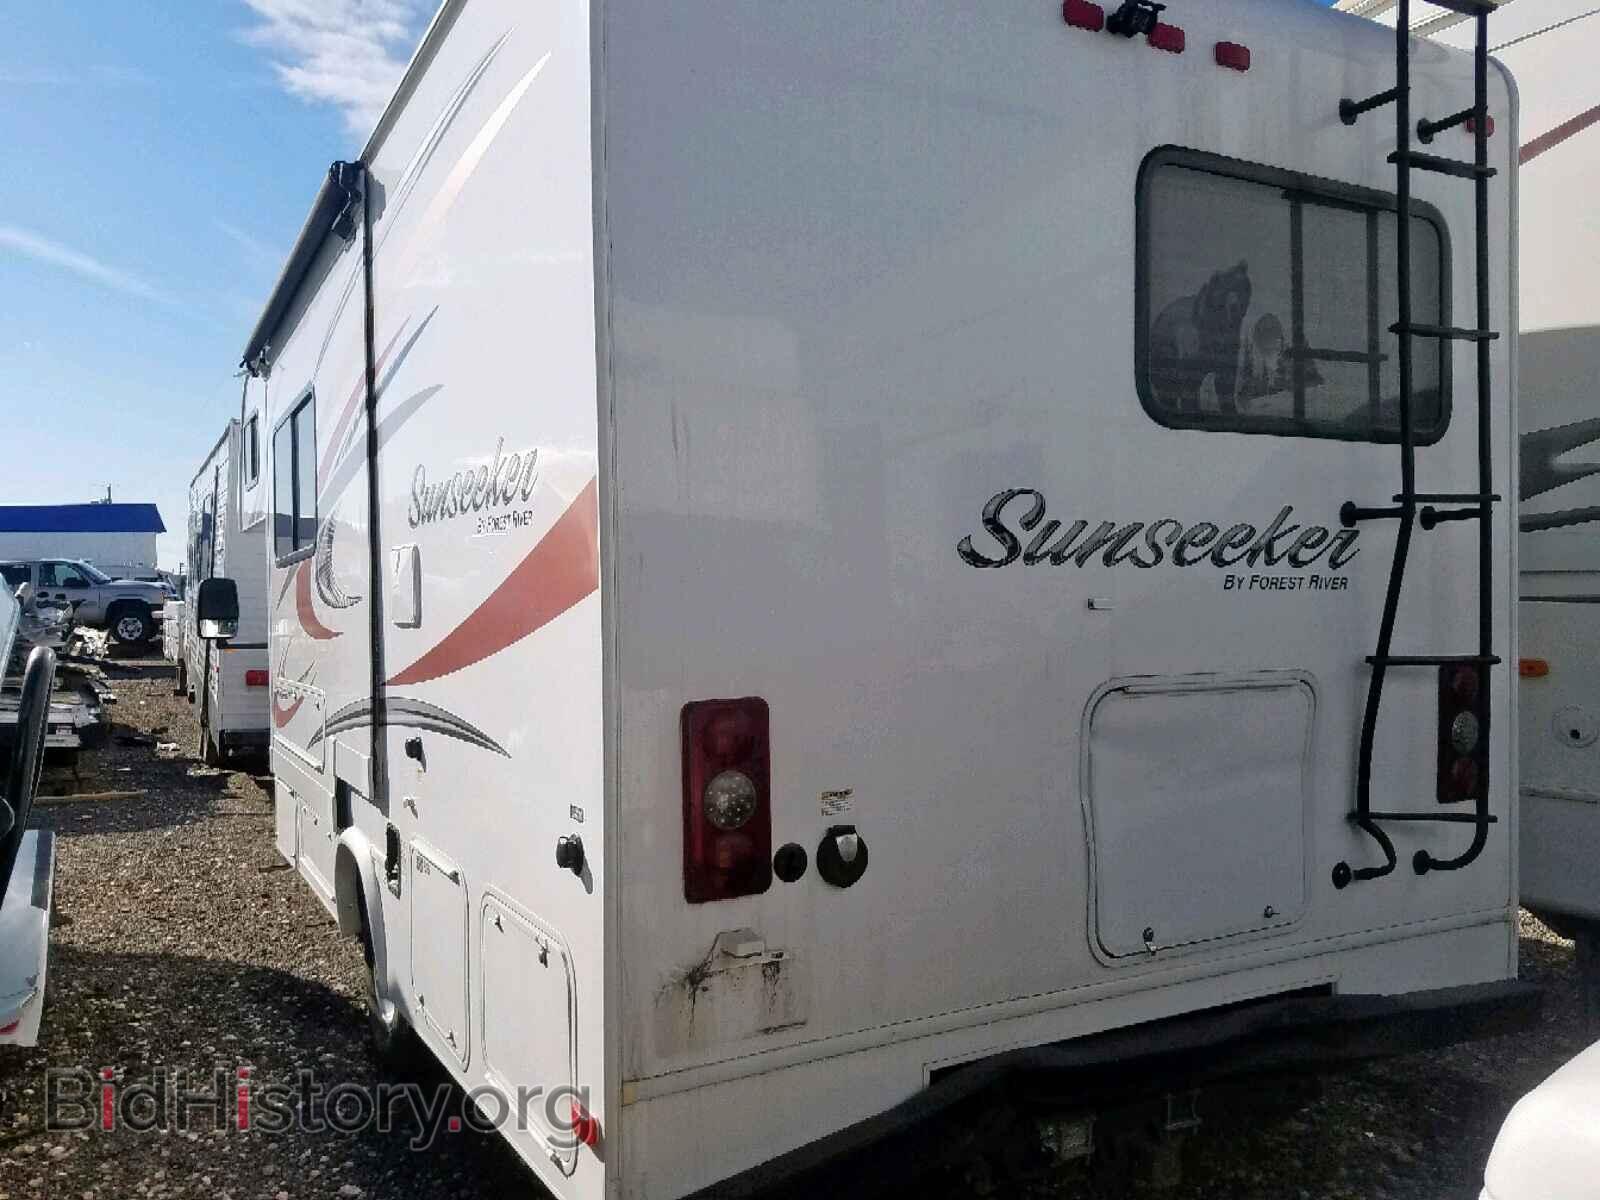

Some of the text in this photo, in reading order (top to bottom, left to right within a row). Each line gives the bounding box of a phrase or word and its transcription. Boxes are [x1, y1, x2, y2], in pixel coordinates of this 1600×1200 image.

[408, 436, 538, 528] Sunseeker
[957, 488, 1360, 568] Sunseeker
[1224, 575, 1348, 590] BY FOREST RIVER
